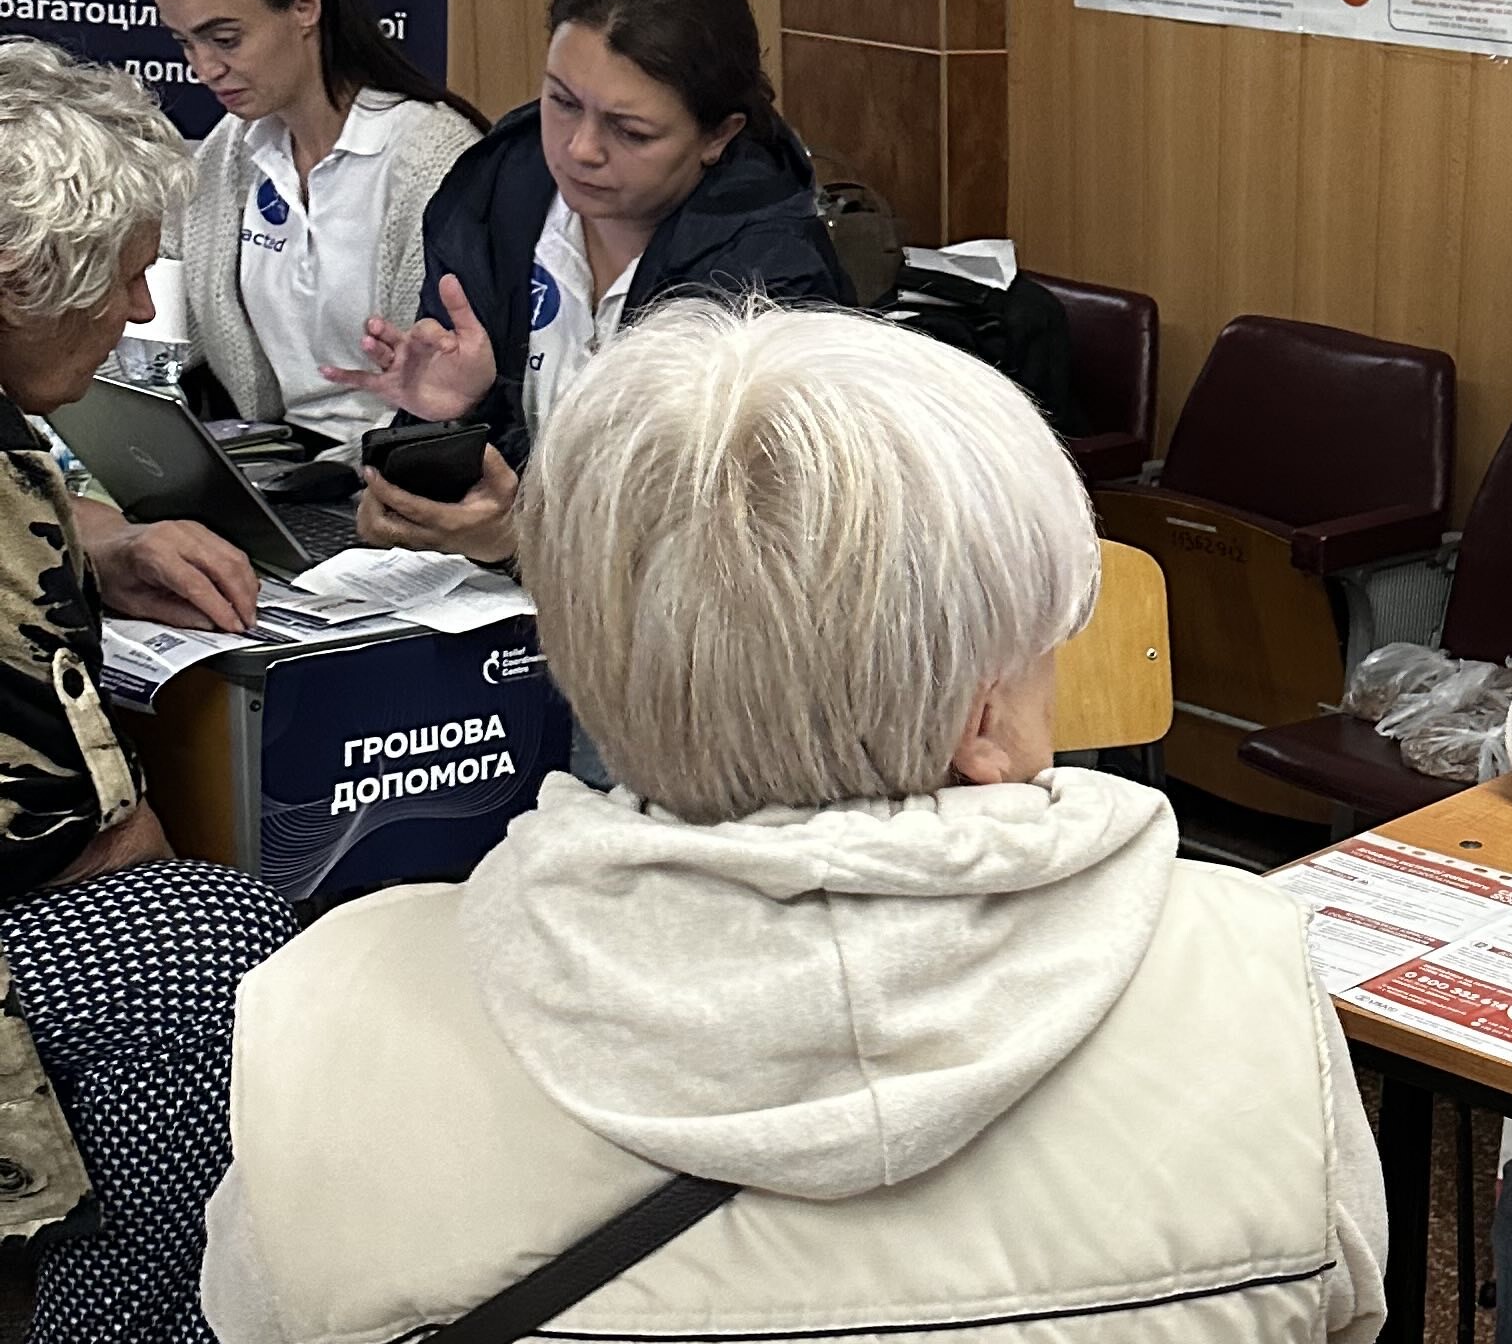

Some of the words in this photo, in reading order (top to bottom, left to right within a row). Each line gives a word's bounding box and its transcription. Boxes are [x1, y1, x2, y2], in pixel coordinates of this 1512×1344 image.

[241, 228, 287, 253] acted
[343, 714, 506, 767] ГРОШОВА
[331, 752, 516, 816] ДОПОМОГА
